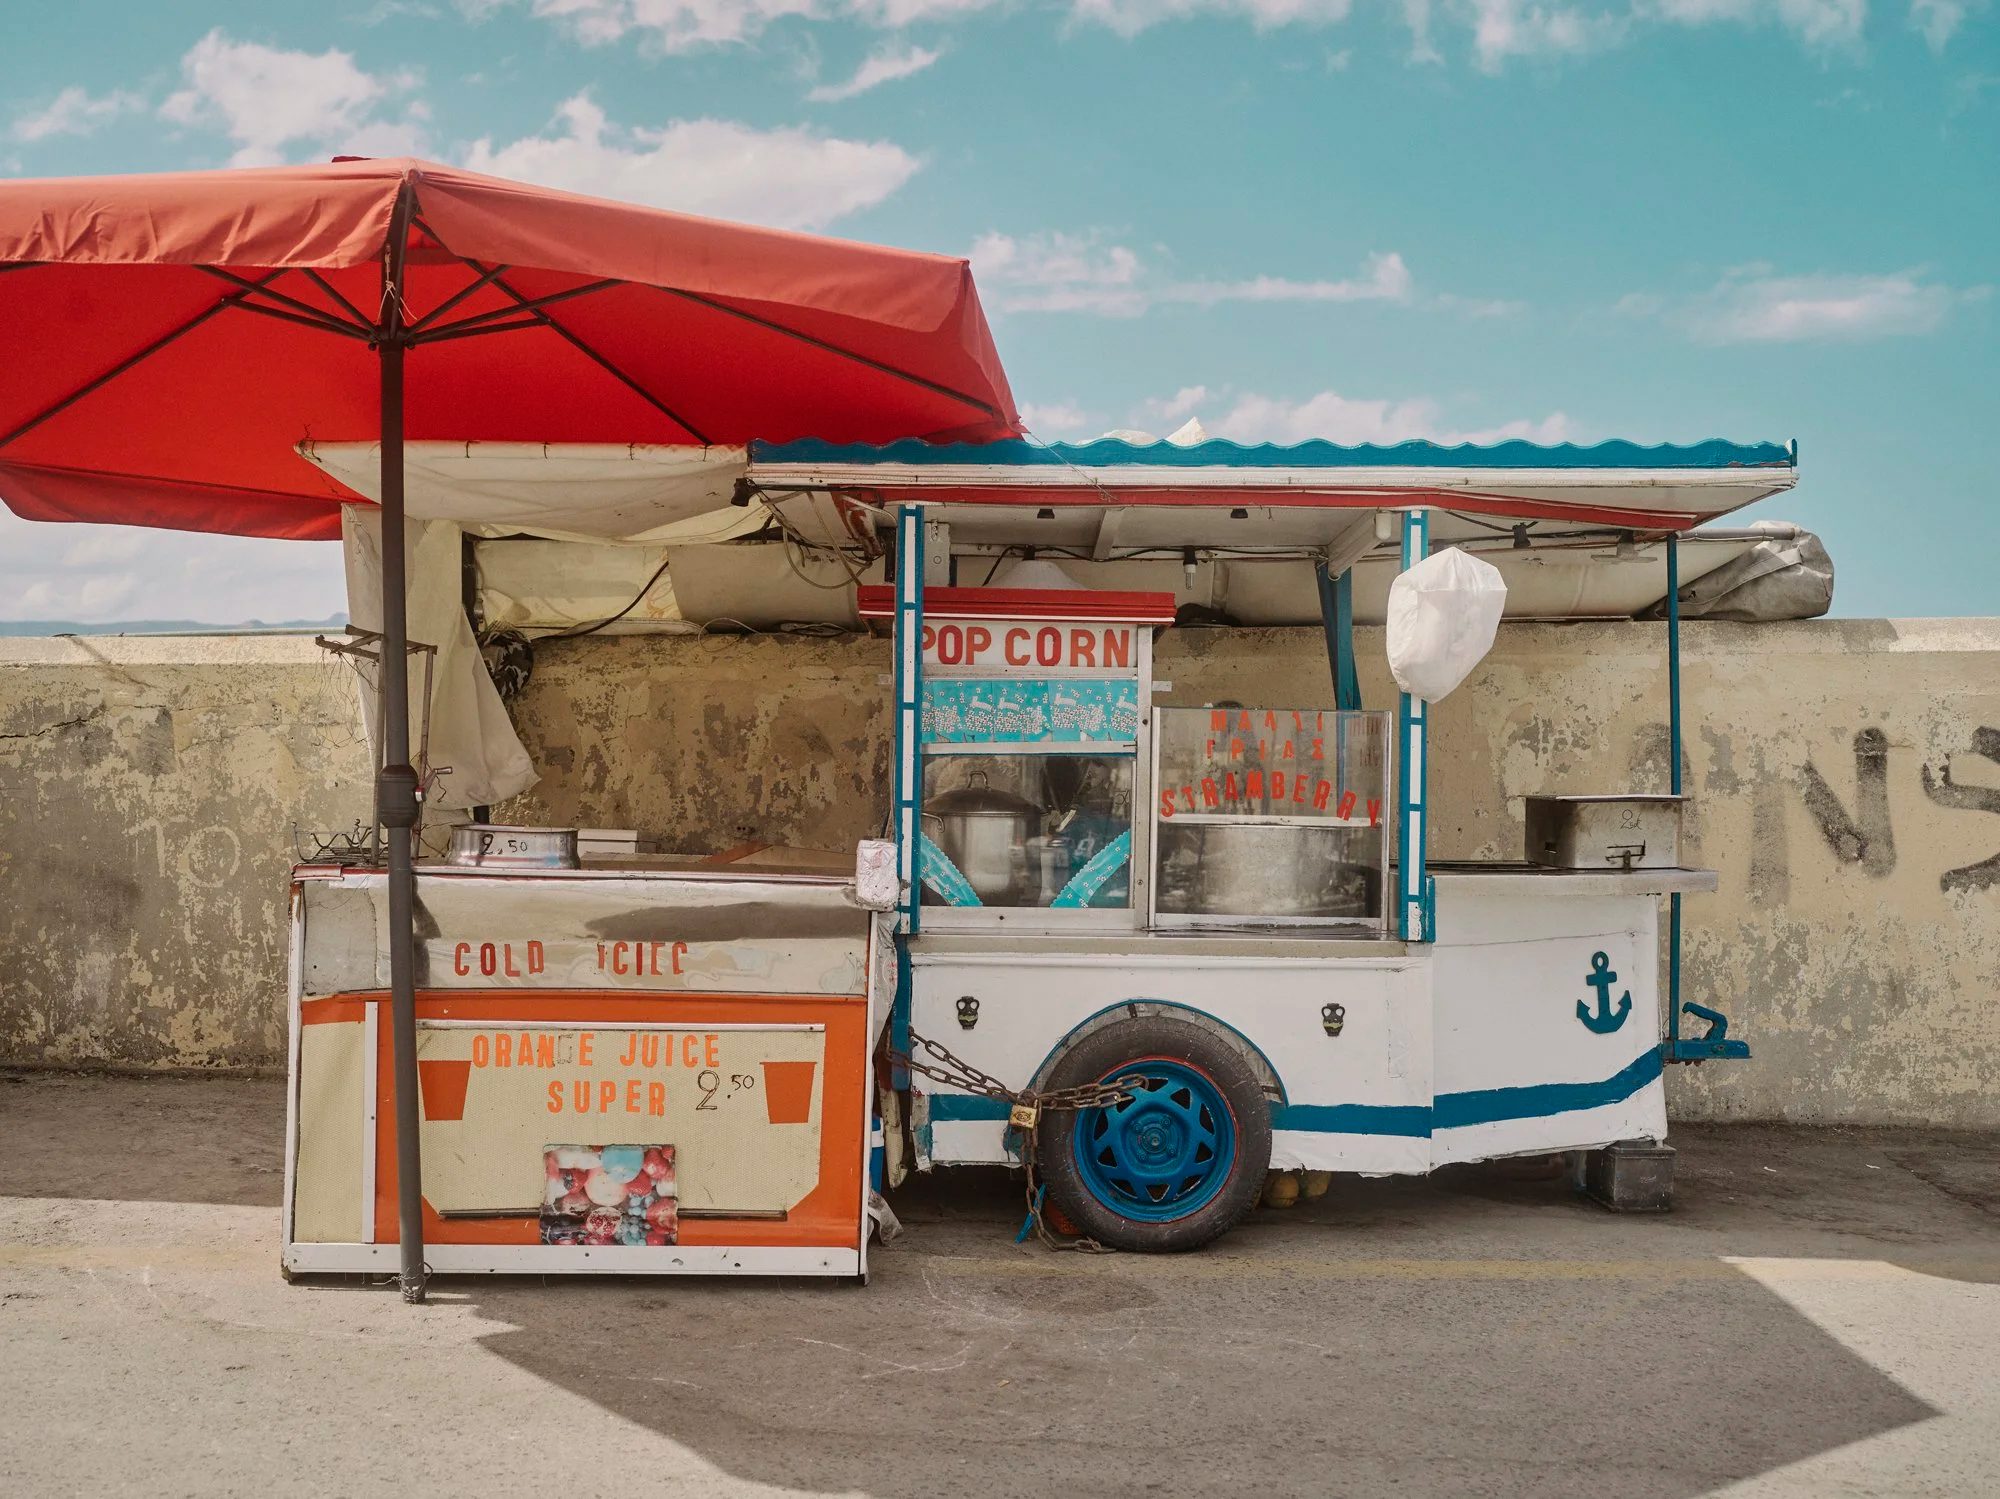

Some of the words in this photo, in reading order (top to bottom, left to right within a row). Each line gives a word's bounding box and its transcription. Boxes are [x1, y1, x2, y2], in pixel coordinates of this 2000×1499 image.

[1005, 626, 1130, 668] CORN
[1160, 770, 1381, 828] STRAMBERRY
[454, 940, 545, 977] COLD
[472, 1032, 594, 1068] ORANE
[619, 1034, 721, 1068] JUICE
[547, 1080, 666, 1117] SUPER
[696, 1070, 755, 1110] 2.50
